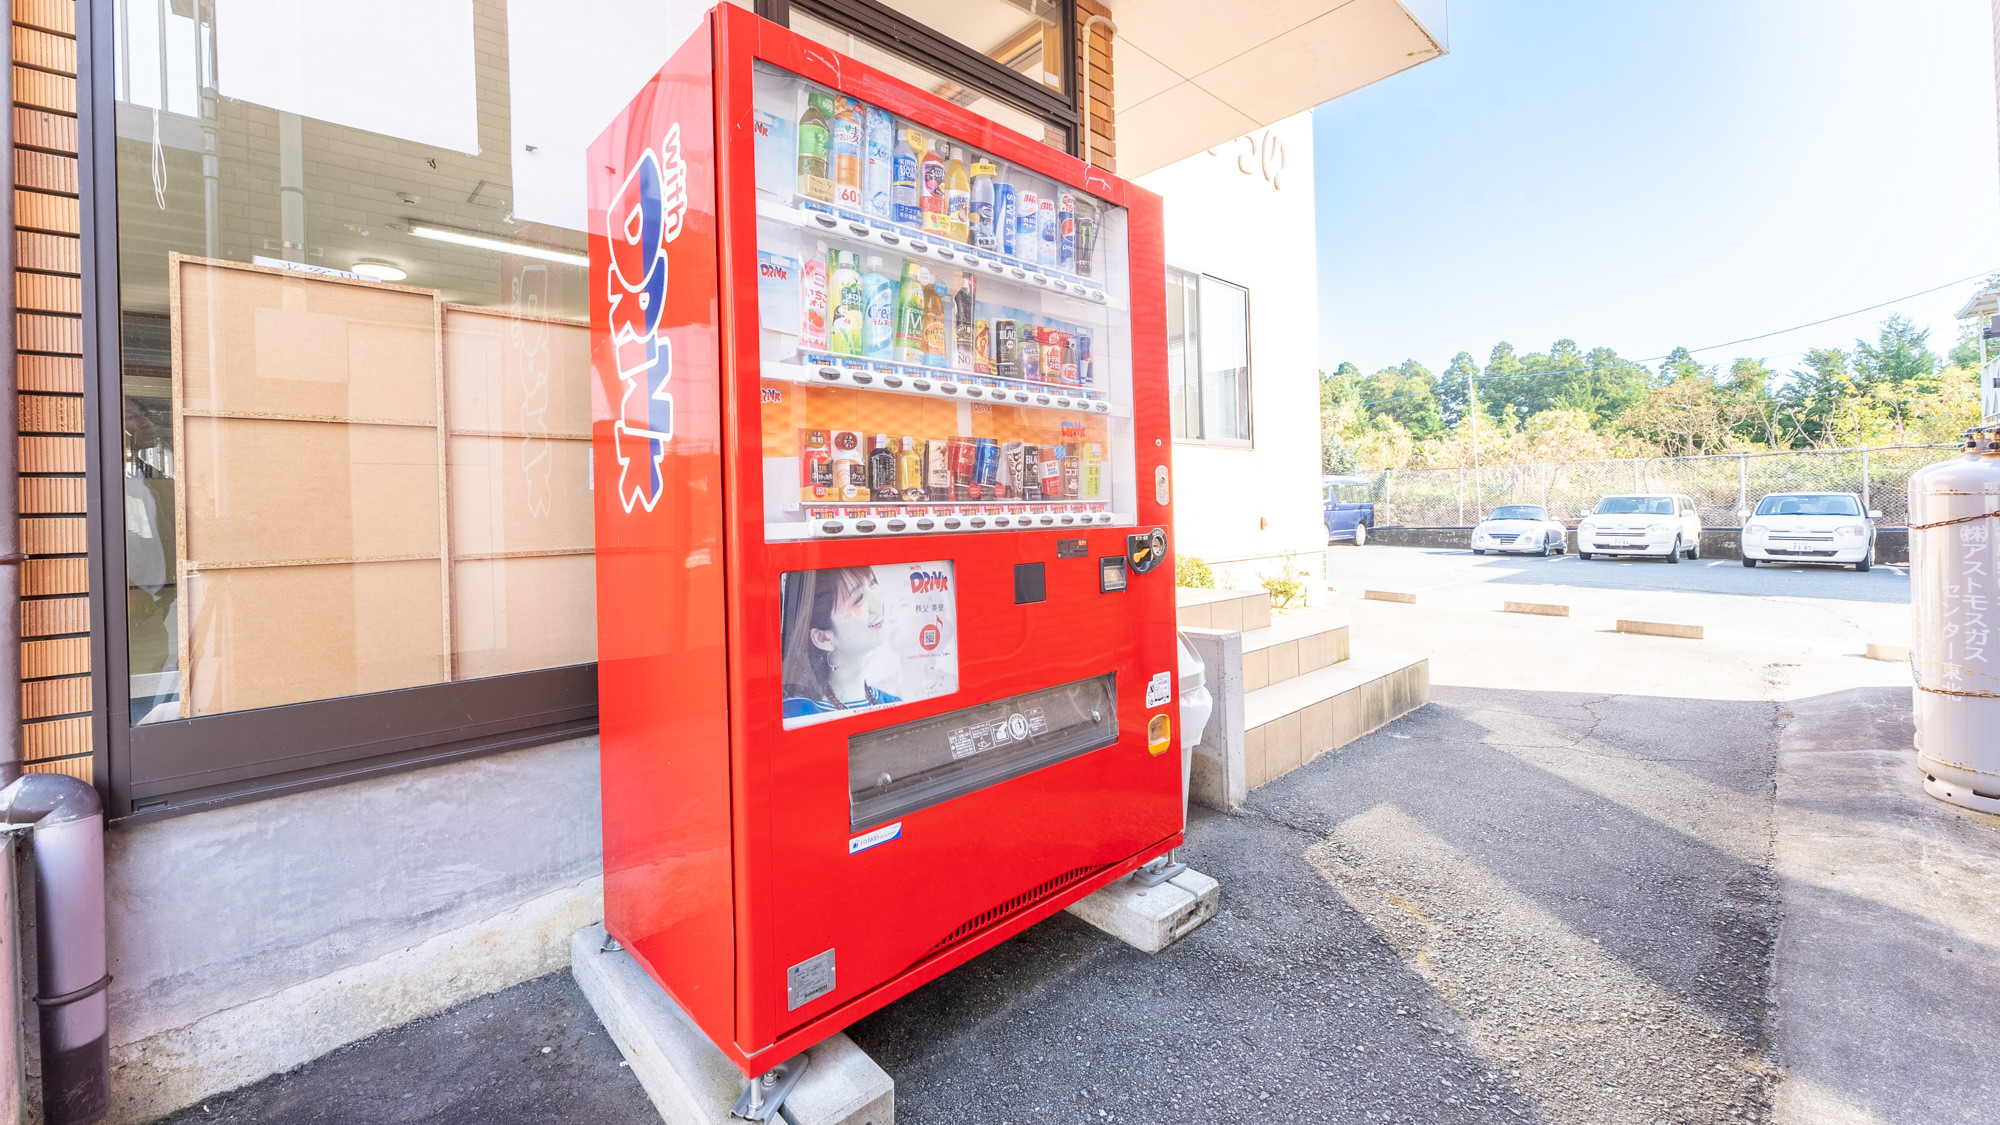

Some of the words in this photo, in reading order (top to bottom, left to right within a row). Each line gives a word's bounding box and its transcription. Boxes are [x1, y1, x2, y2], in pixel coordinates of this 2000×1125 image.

[662, 122, 687, 243] with
[1024, 193, 1037, 203] BIG
[1040, 201, 1053, 211] BIG
[1005, 193, 1014, 247] SWEAT
[760, 263, 787, 280] DRINK
[606, 147, 674, 514] DRINK
[909, 571, 949, 594] DRINK
